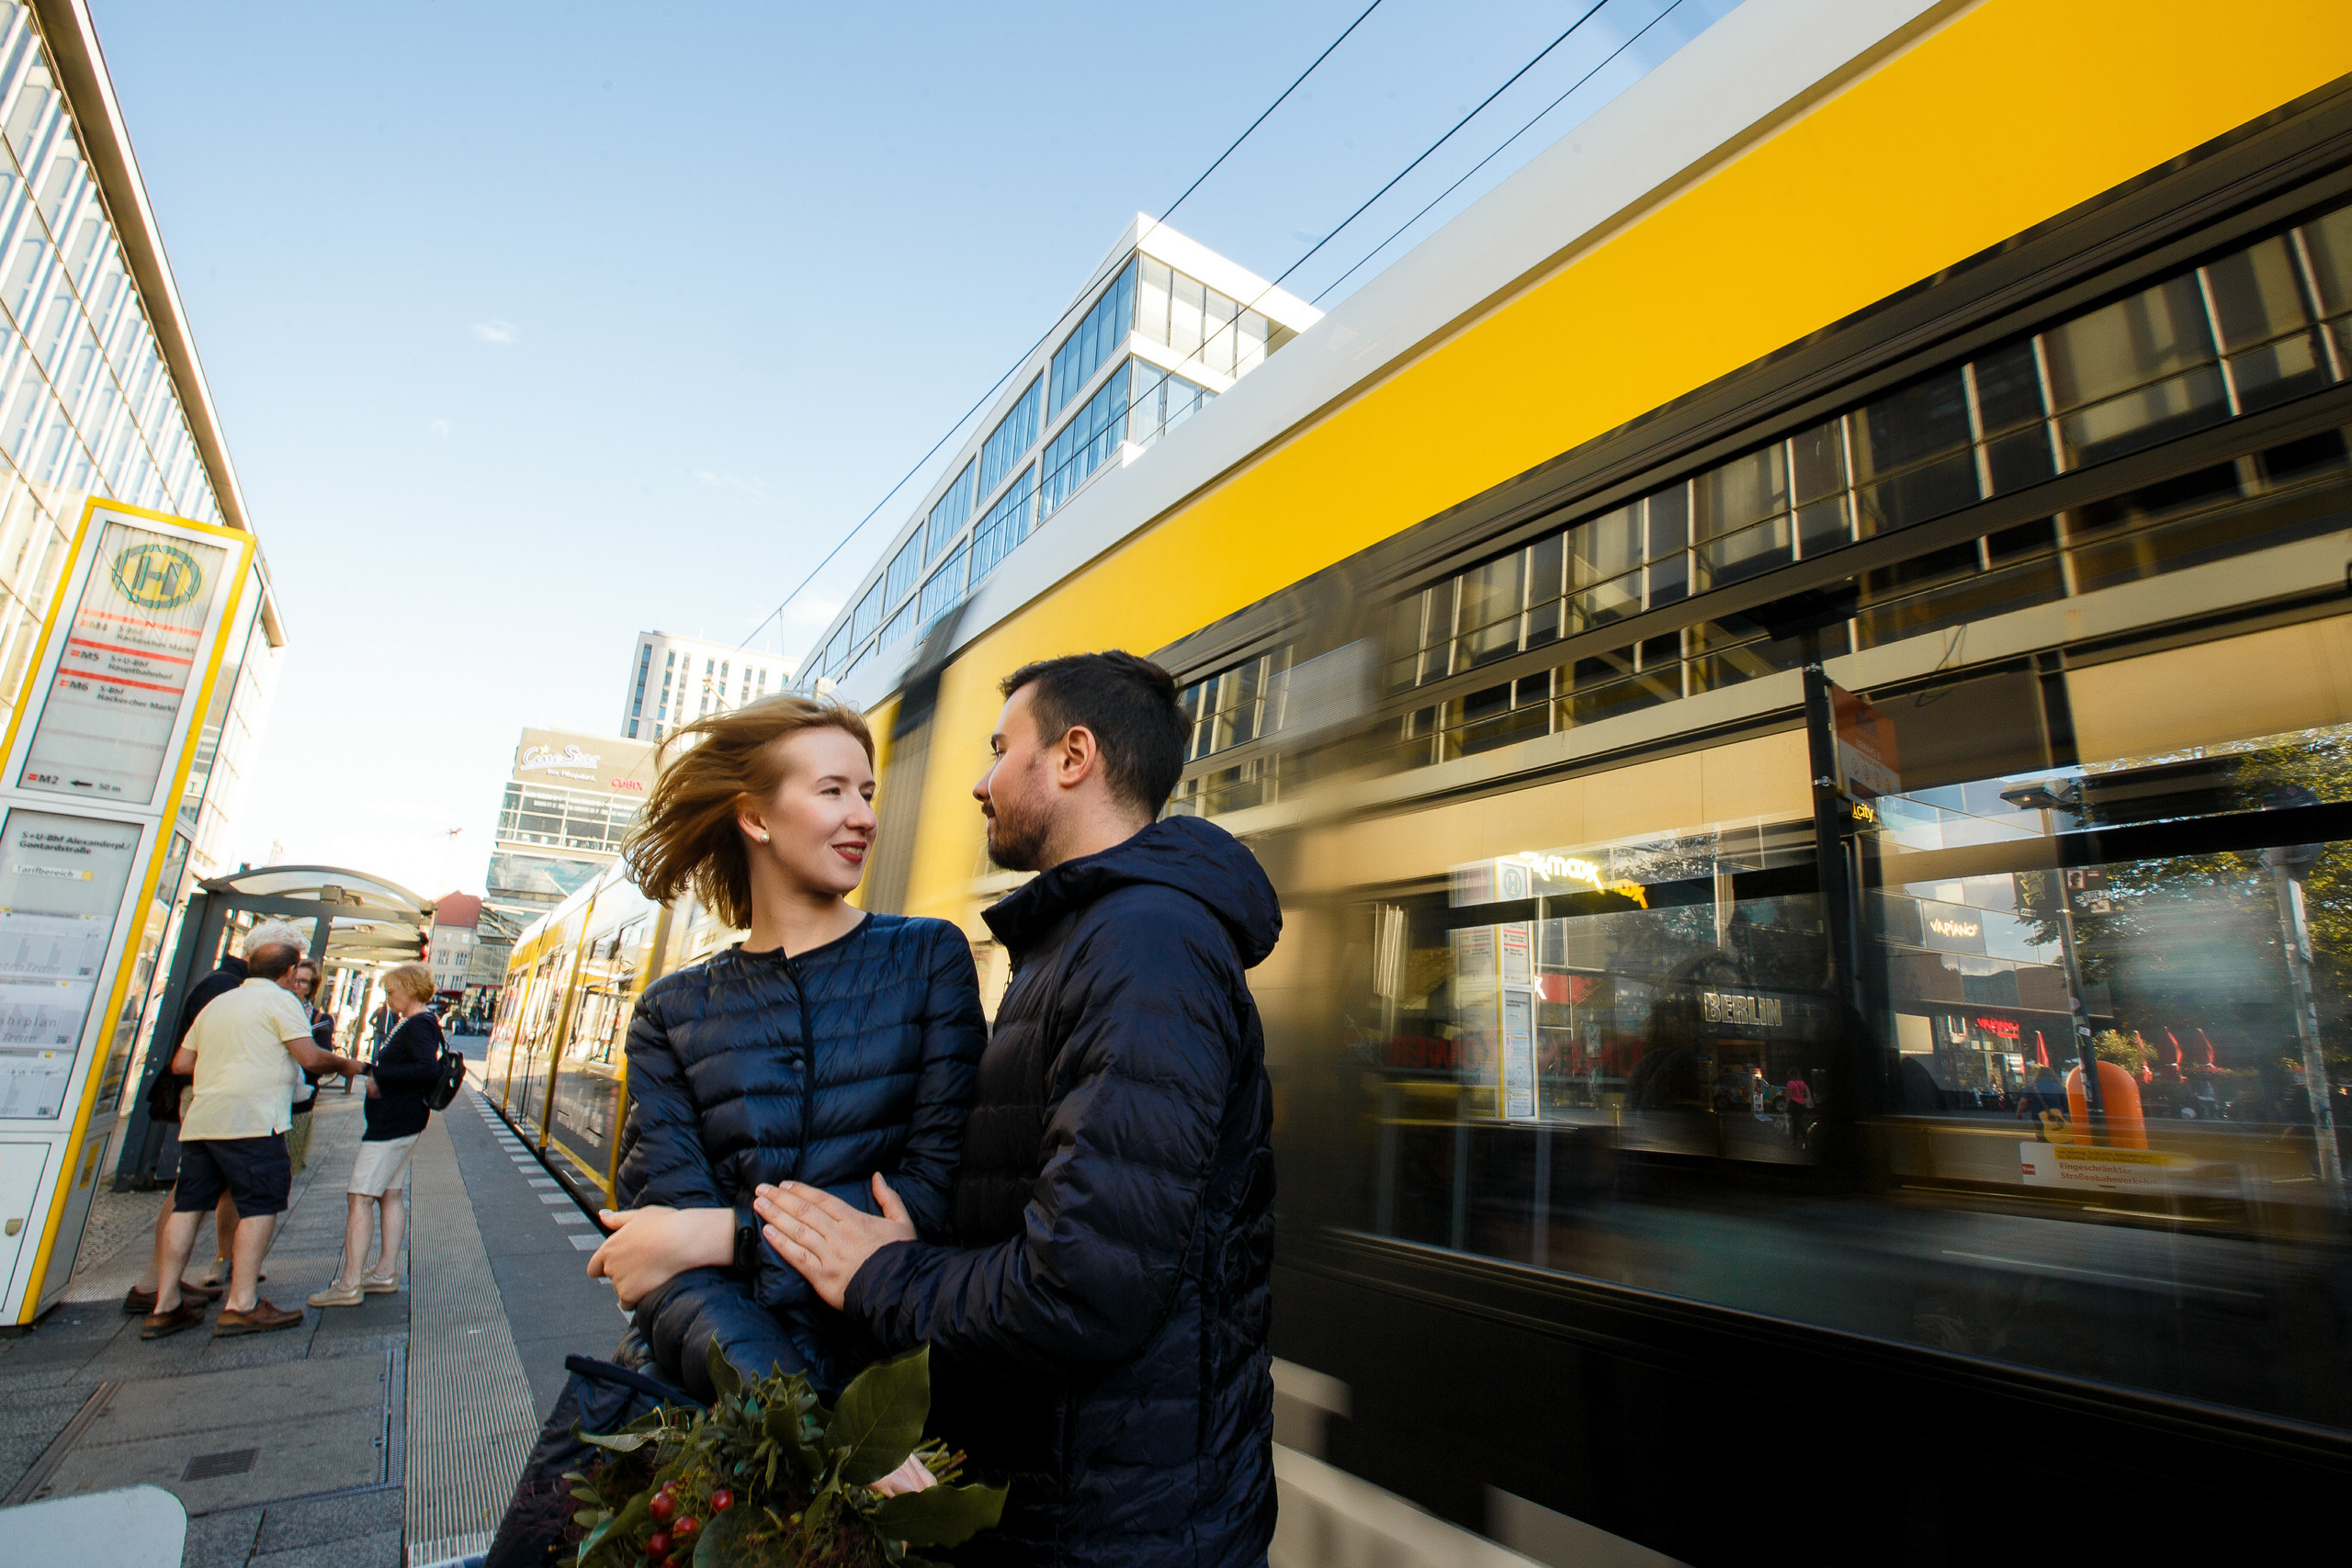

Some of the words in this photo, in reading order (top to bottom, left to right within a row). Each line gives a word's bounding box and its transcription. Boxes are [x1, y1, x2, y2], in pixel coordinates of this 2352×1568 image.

[80, 650, 100, 661] M5
[107, 663, 173, 680] Hauptbahnhof
[69, 681, 89, 691] M6
[149, 702, 177, 712] Markt
[522, 744, 602, 766] CineStar
[39, 774, 60, 785] M2
[22, 830, 64, 842] S+U-Bhf
[19, 840, 92, 855] Gontardstraße
[1703, 992, 1782, 1027] BERLIN
[2059, 1161, 2132, 1175] Eingeschränkter
